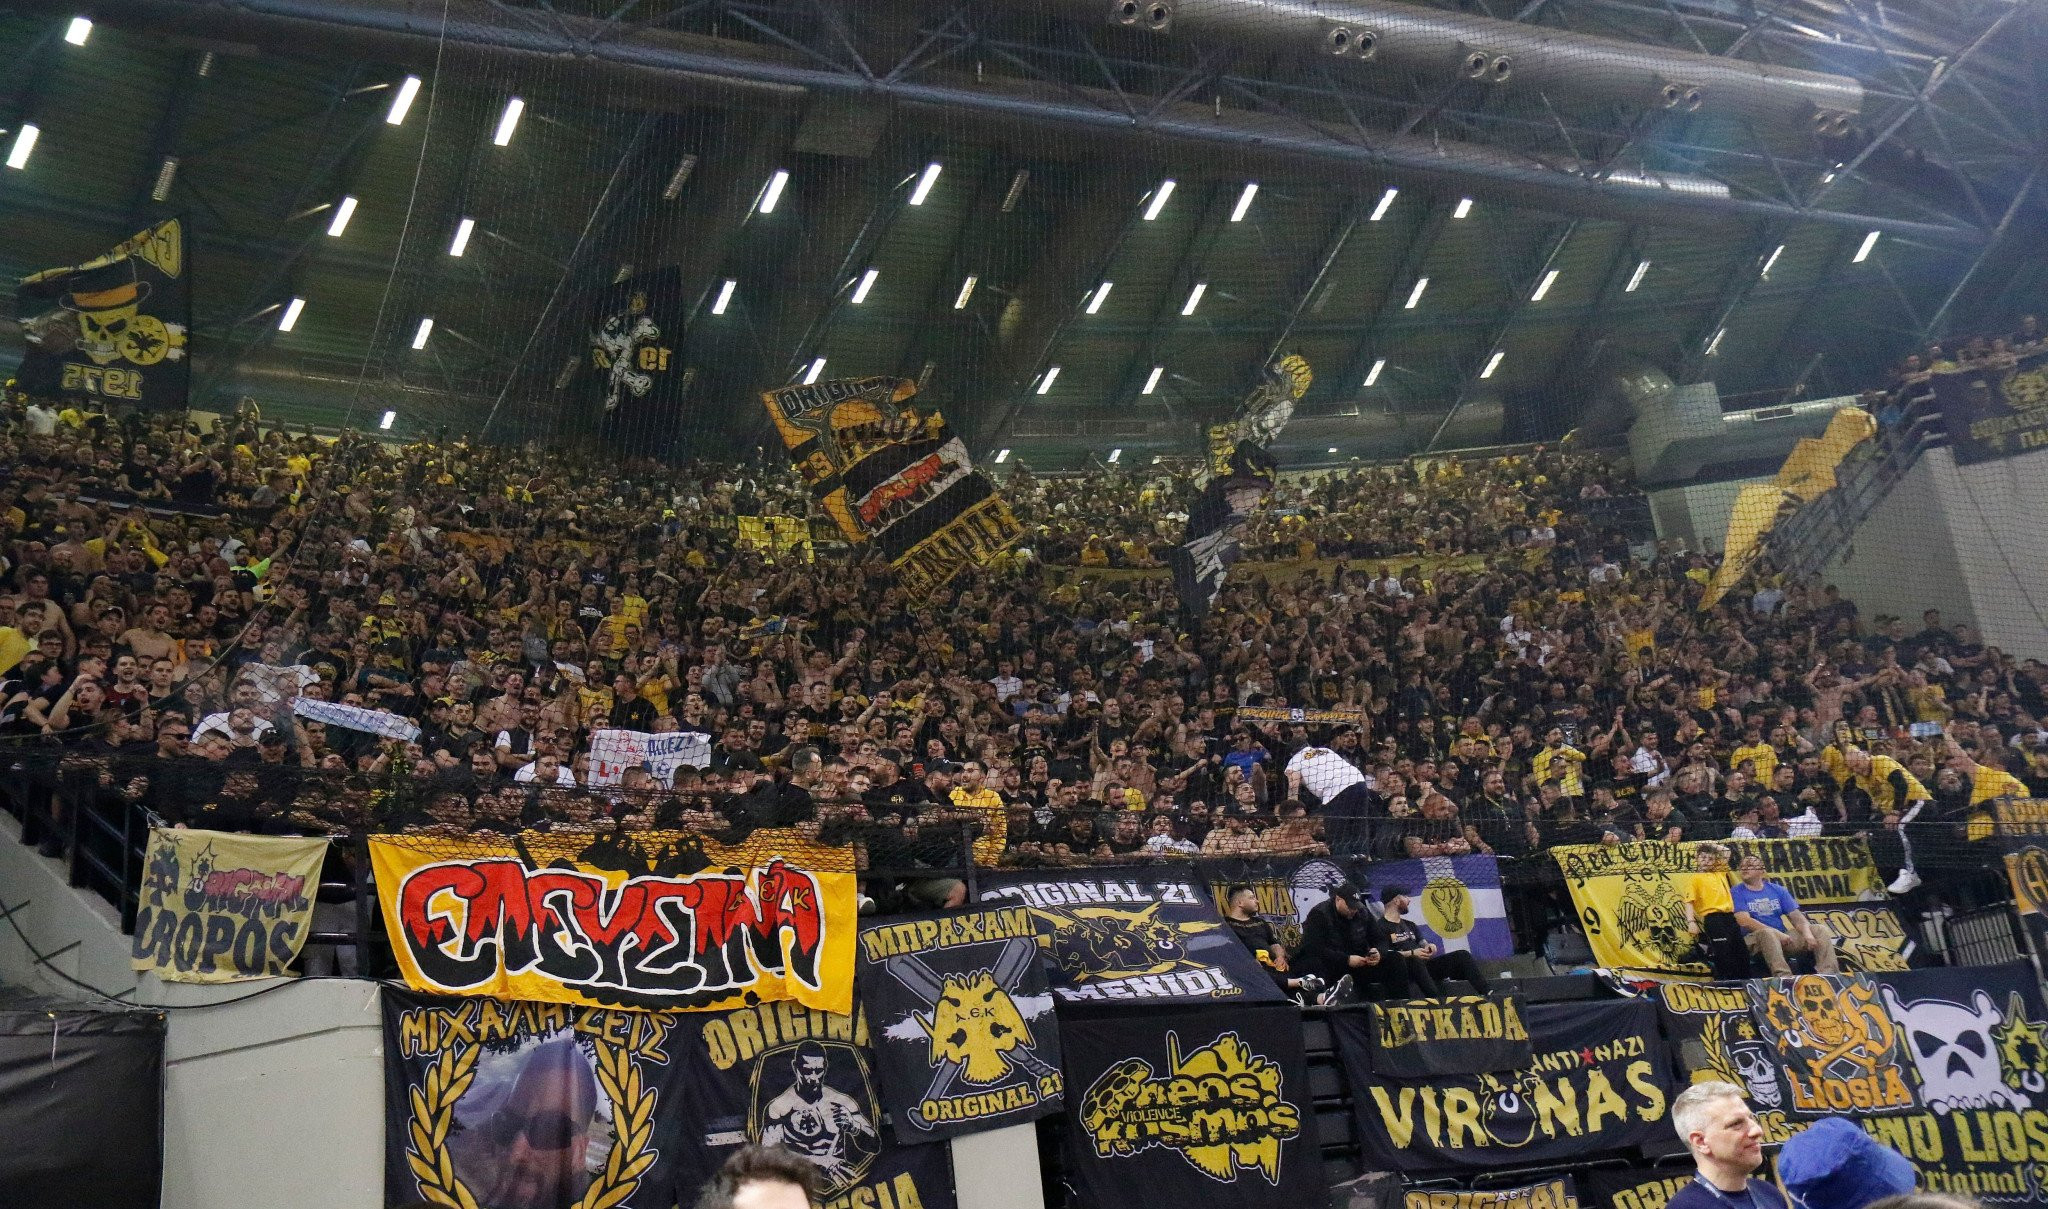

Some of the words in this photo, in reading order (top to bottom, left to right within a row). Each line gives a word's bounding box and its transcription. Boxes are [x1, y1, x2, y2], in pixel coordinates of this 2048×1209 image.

[1156, 883, 1199, 903] 21
[1866, 908, 1904, 938] 21
[1530, 1050, 1580, 1074] ANTI
[1594, 1036, 1645, 1062] NAZI
[921, 1085, 1036, 1122] ORIGINAL
[1038, 1073, 1064, 1097] 21
[1788, 1068, 1914, 1110] LIOSIA
